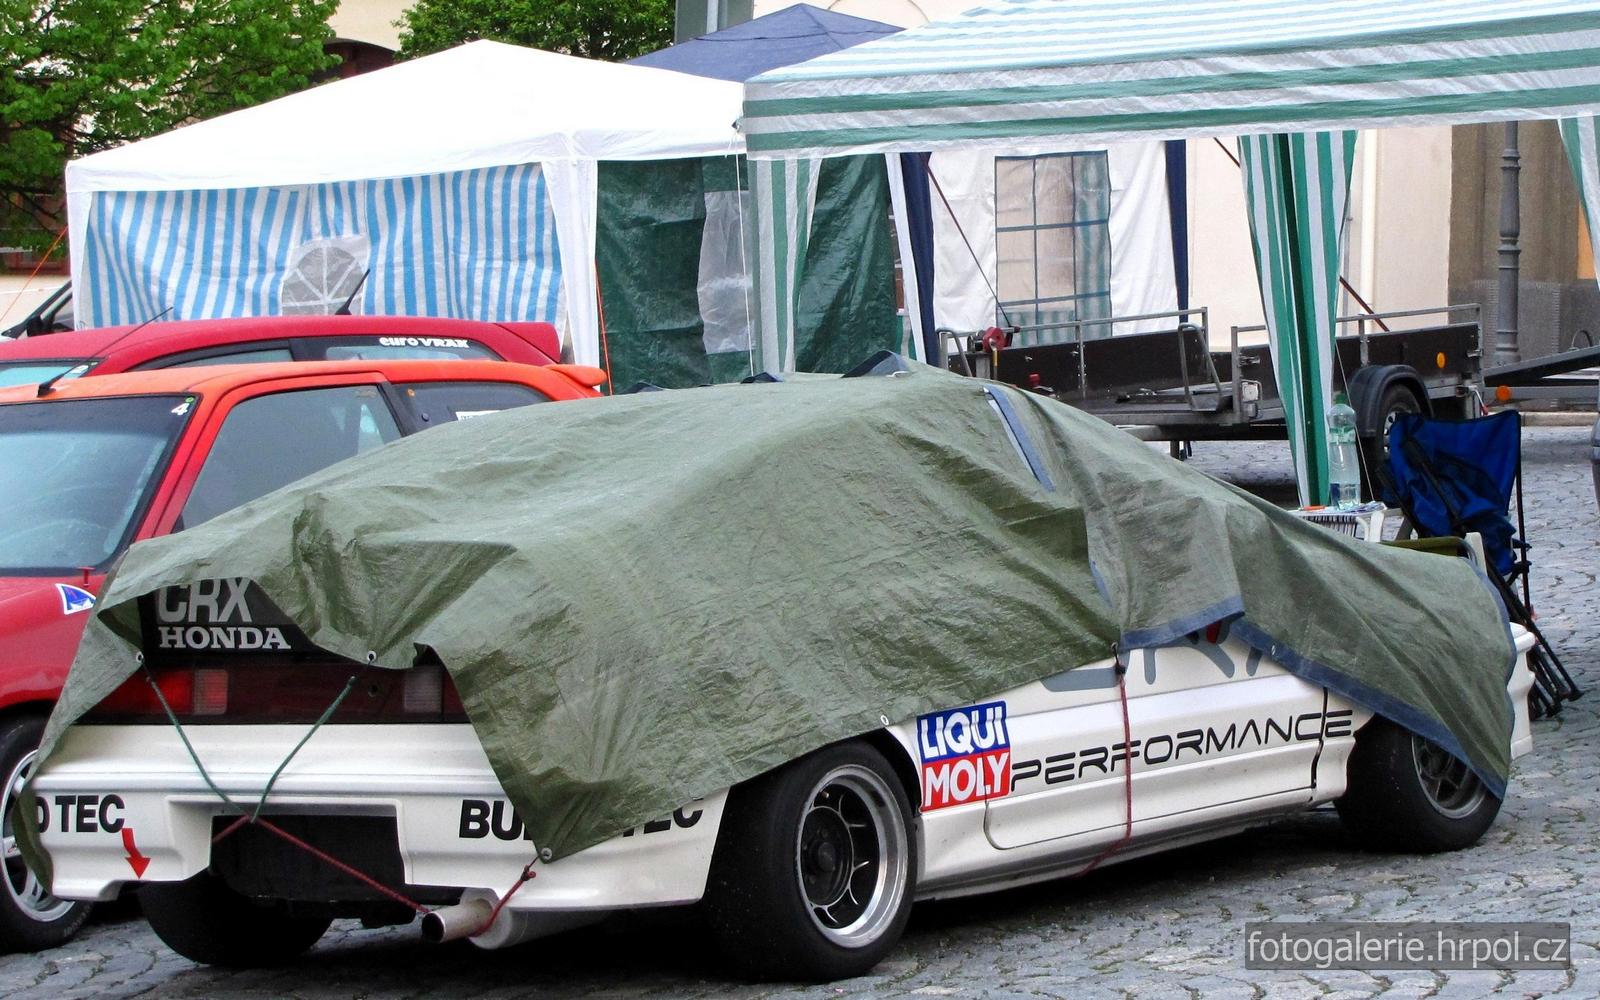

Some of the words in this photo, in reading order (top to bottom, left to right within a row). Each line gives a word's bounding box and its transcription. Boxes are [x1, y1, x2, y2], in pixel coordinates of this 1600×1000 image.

[379, 337, 419, 347] euro
[171, 402, 190, 416] 4
[158, 577, 253, 623] CRX
[158, 626, 292, 650] HONDA
[920, 706, 1007, 759] LIQUI
[1011, 709, 1353, 792] PERFORMANCE
[924, 752, 1010, 808] MOLY
[55, 794, 126, 834] TEC
